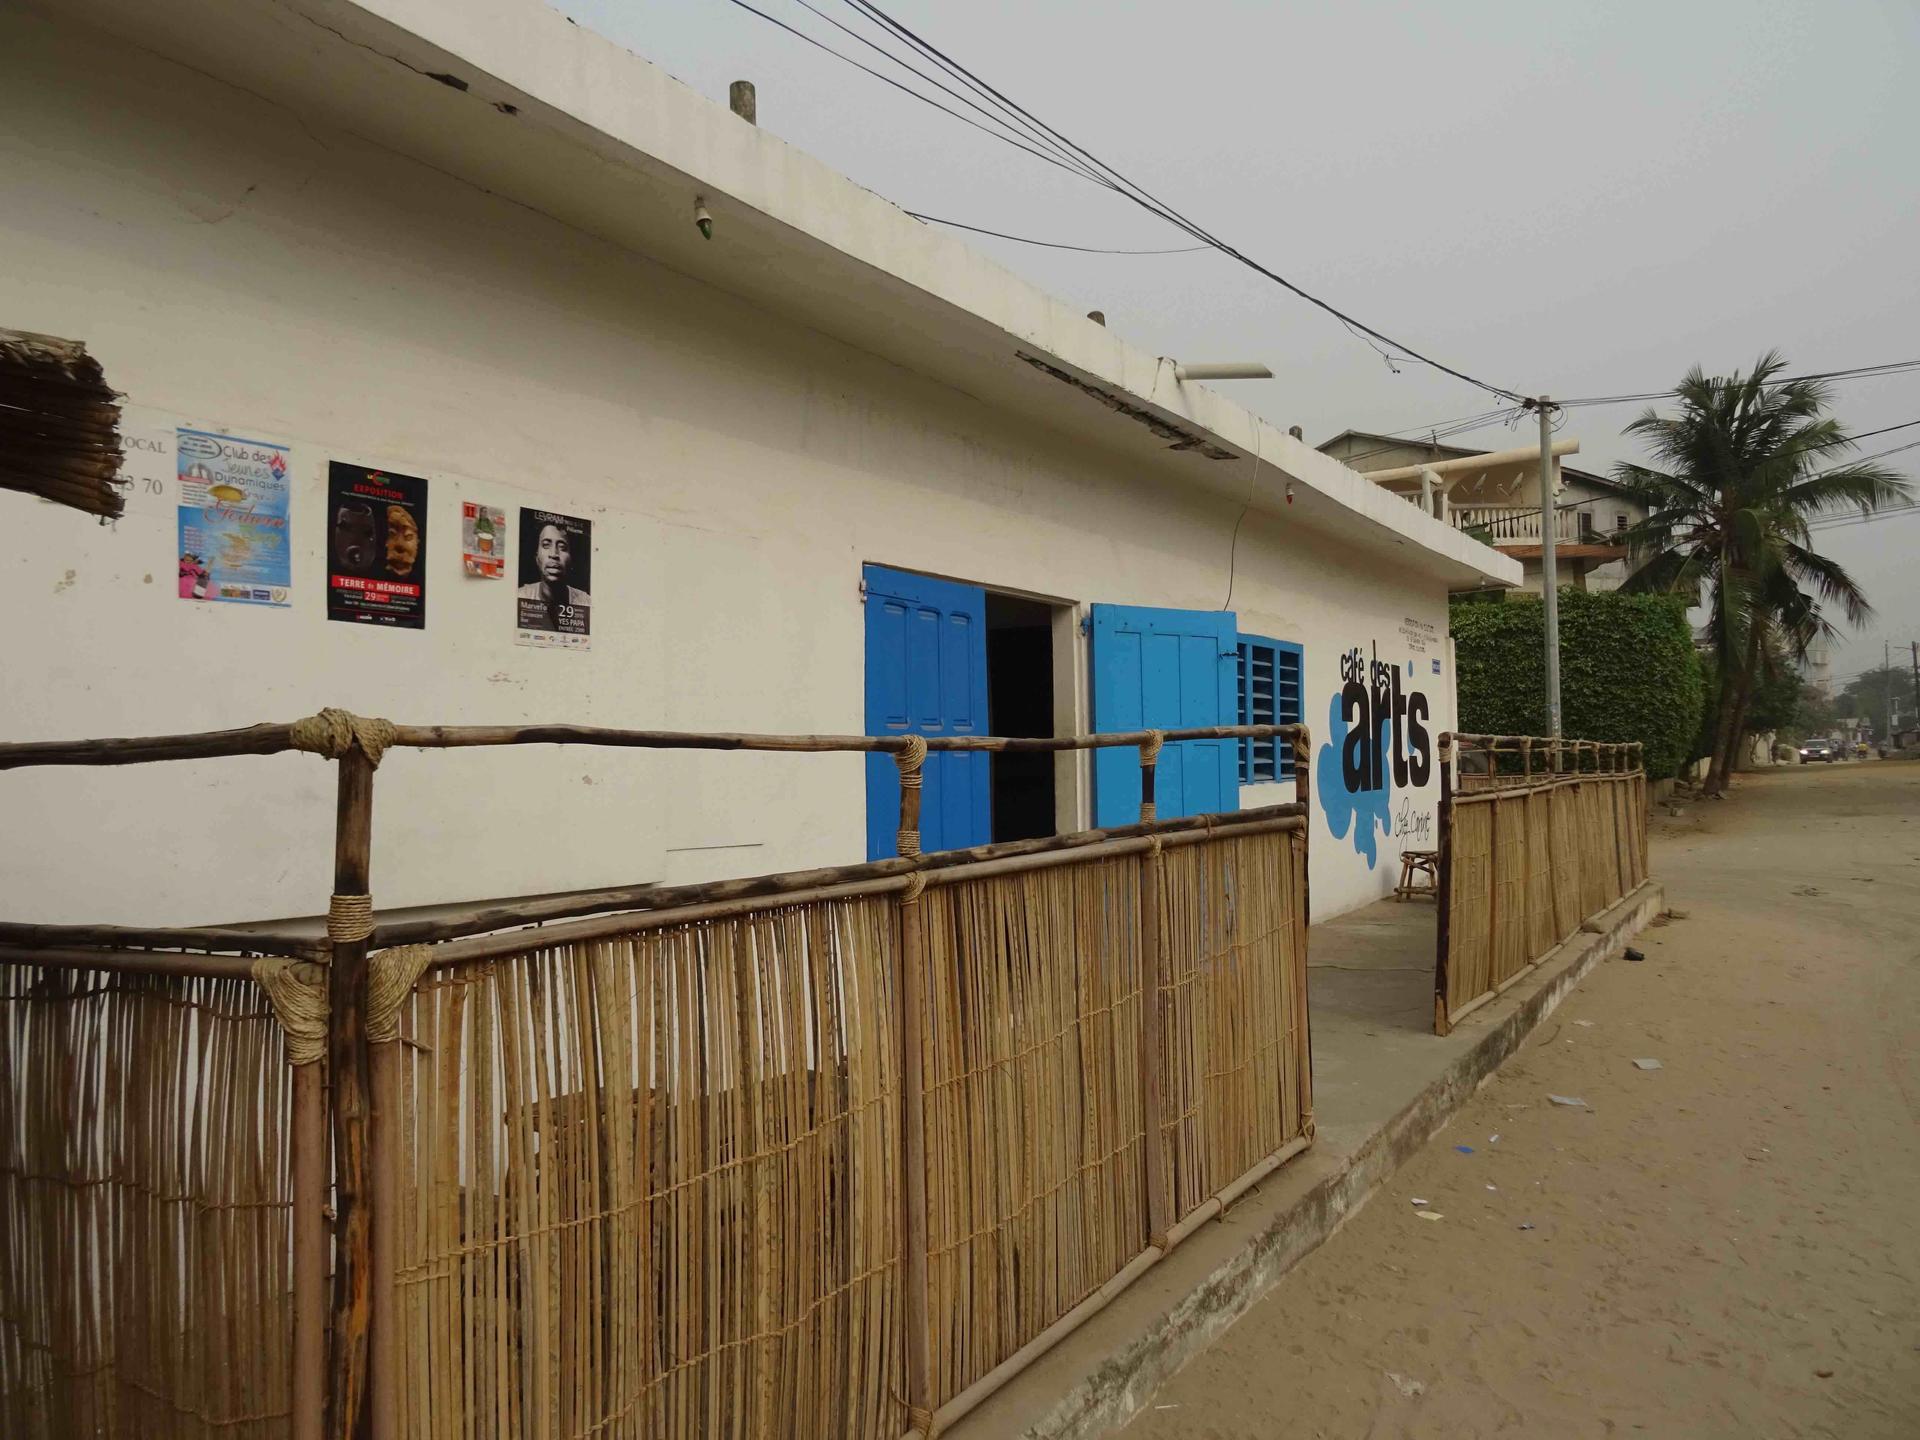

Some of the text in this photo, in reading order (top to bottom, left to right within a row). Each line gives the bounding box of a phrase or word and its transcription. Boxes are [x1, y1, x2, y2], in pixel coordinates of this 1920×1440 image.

[121, 436, 167, 454] OCAL
[223, 445, 249, 460] Club
[252, 450, 271, 464] des
[142, 478, 163, 495] 70
[214, 471, 285, 491] Dynamiques
[353, 484, 404, 500] EXPOSITION
[340, 578, 365, 589] TERRE
[377, 582, 414, 595] MÉMOIRE
[365, 591, 376, 601] 29
[558, 604, 574, 618] 29
[559, 618, 585, 627] YES PAPA
[1340, 639, 1390, 687] café des
[1341, 664, 1430, 793] arts
